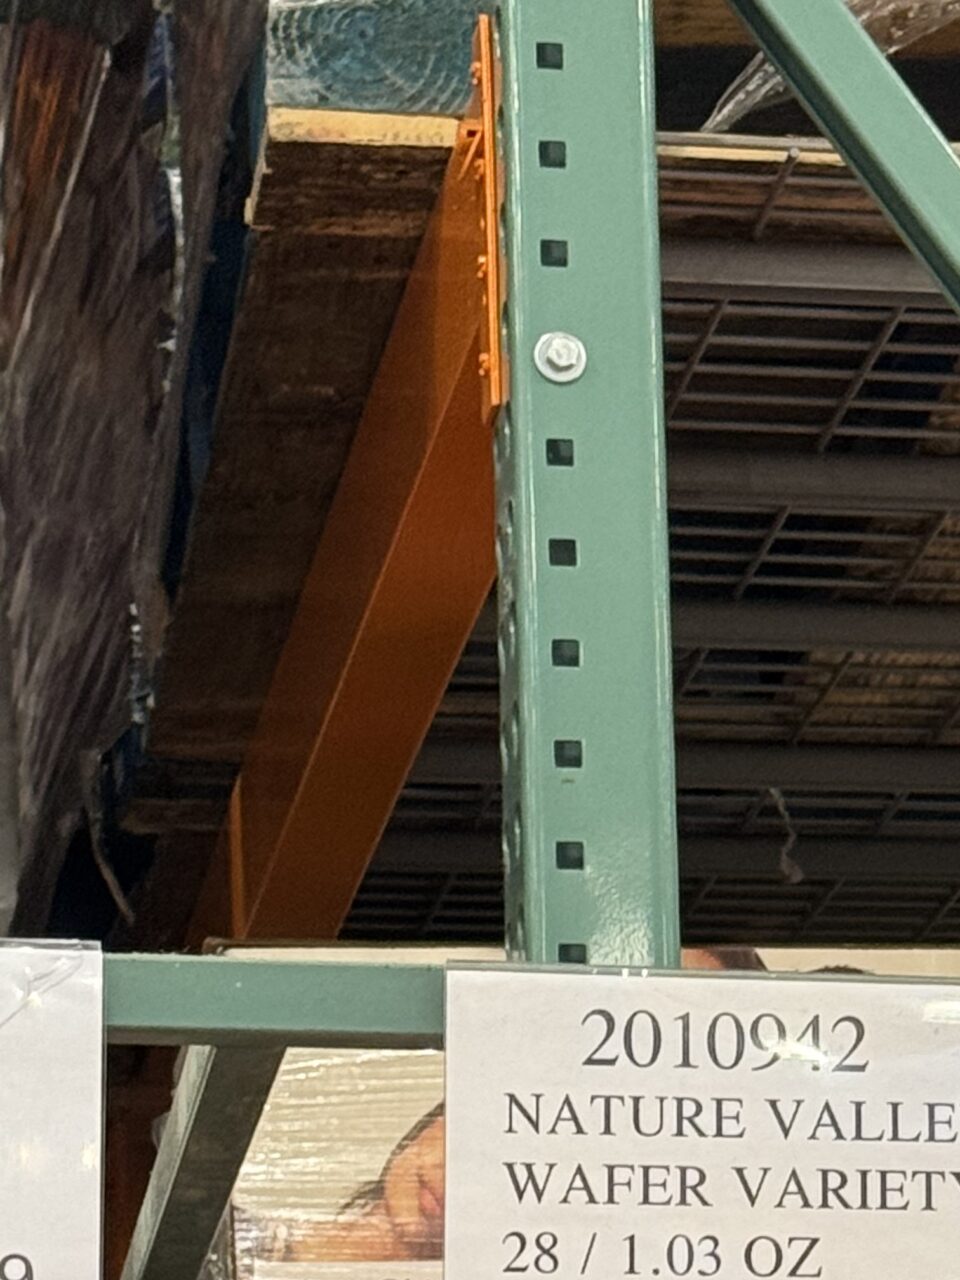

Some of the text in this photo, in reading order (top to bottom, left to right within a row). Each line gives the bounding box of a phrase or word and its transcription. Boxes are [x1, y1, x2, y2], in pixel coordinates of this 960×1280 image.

[581, 1008, 869, 1073] 2010942
[503, 1092, 747, 1139] NATURE
[502, 1162, 713, 1207] WAFER
[502, 1231, 823, 1278] 28 / 1.03 OZ
